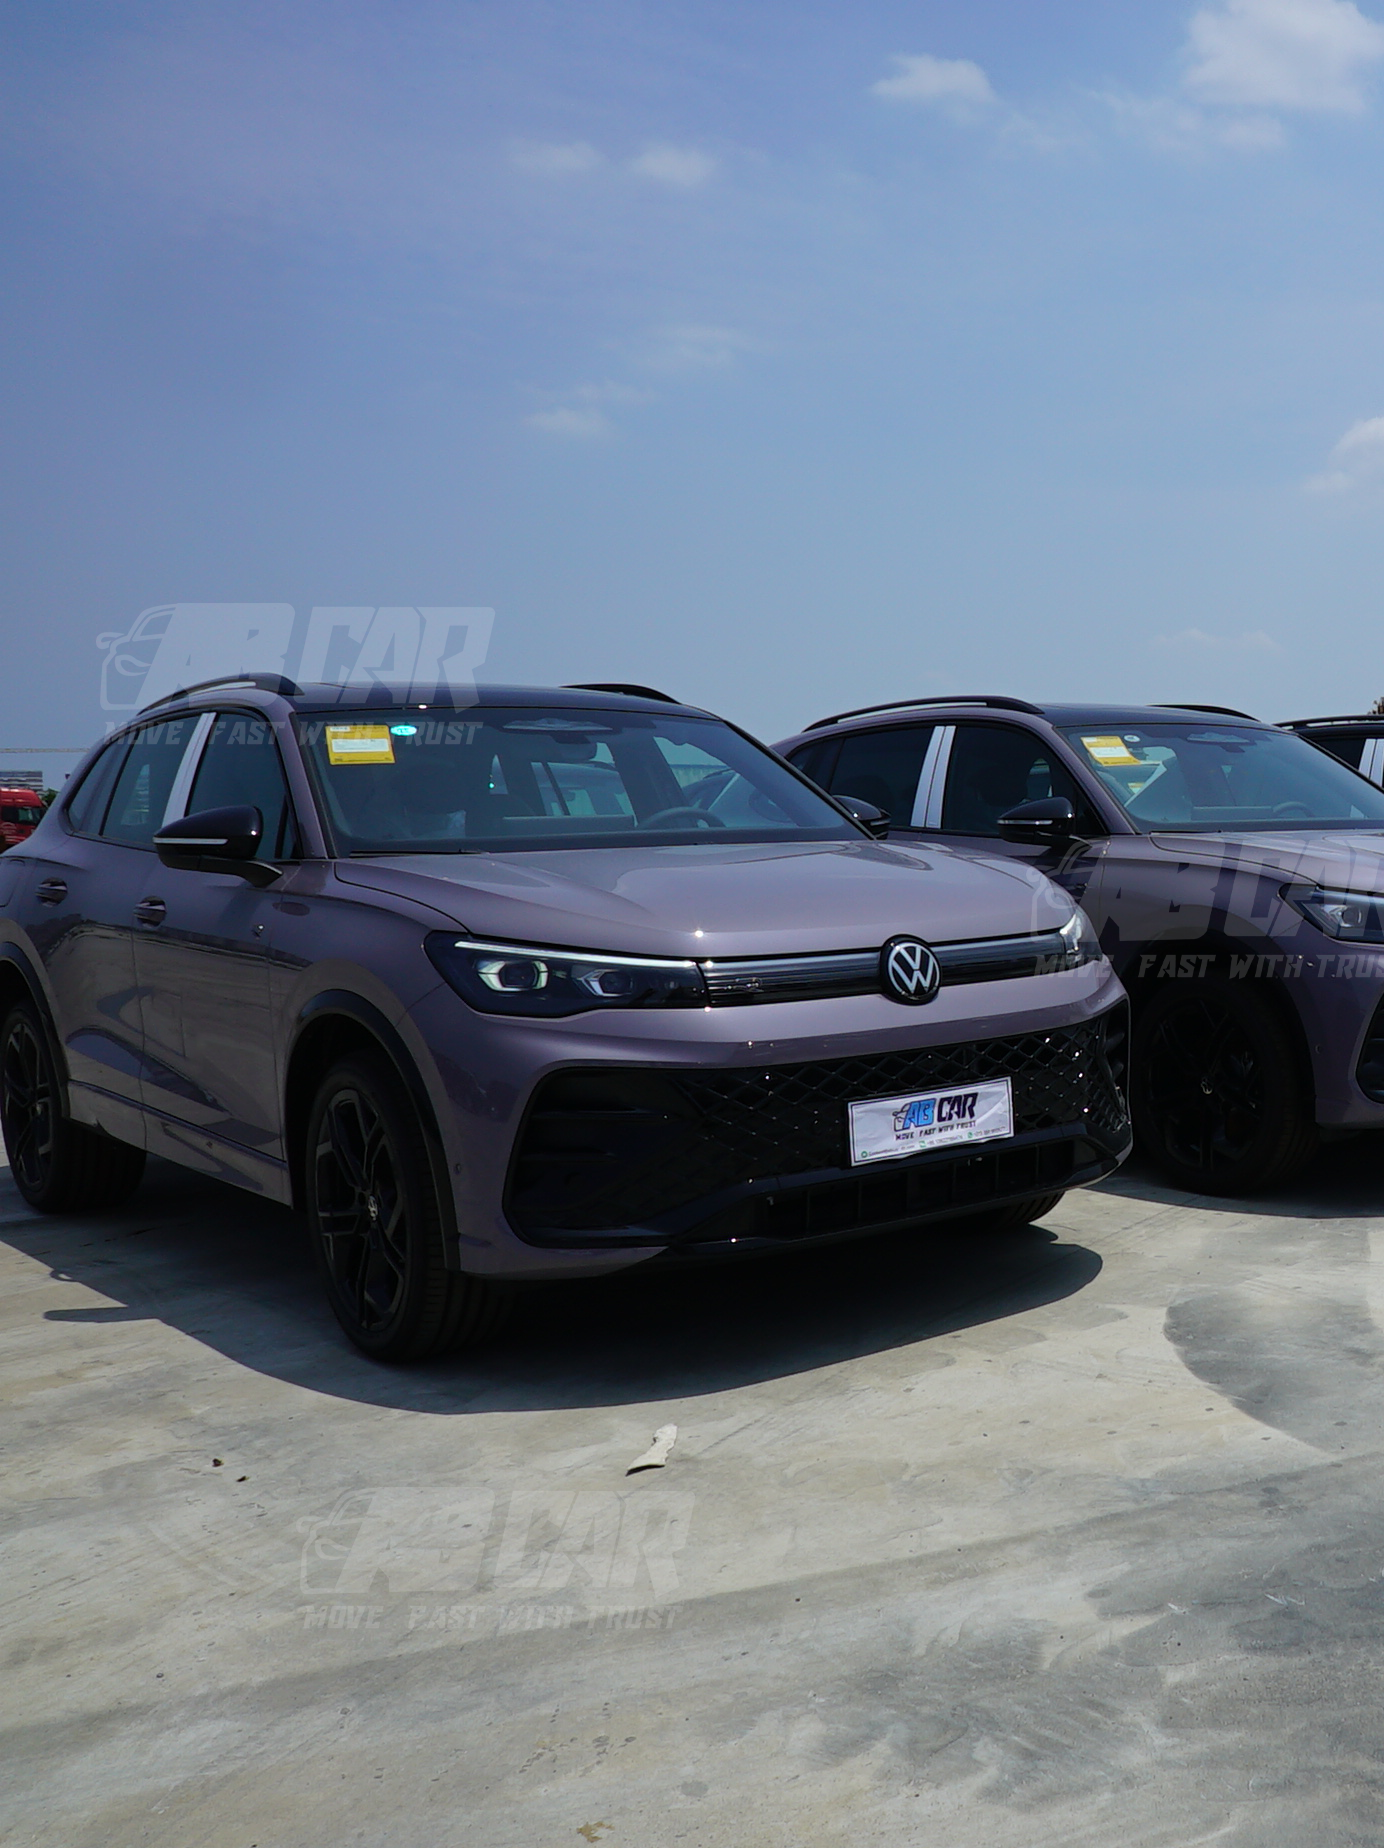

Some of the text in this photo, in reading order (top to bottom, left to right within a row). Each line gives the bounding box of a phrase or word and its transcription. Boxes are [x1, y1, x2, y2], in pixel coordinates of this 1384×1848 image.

[889, 943, 938, 996] VW
[902, 1092, 979, 1130] AB CAR
